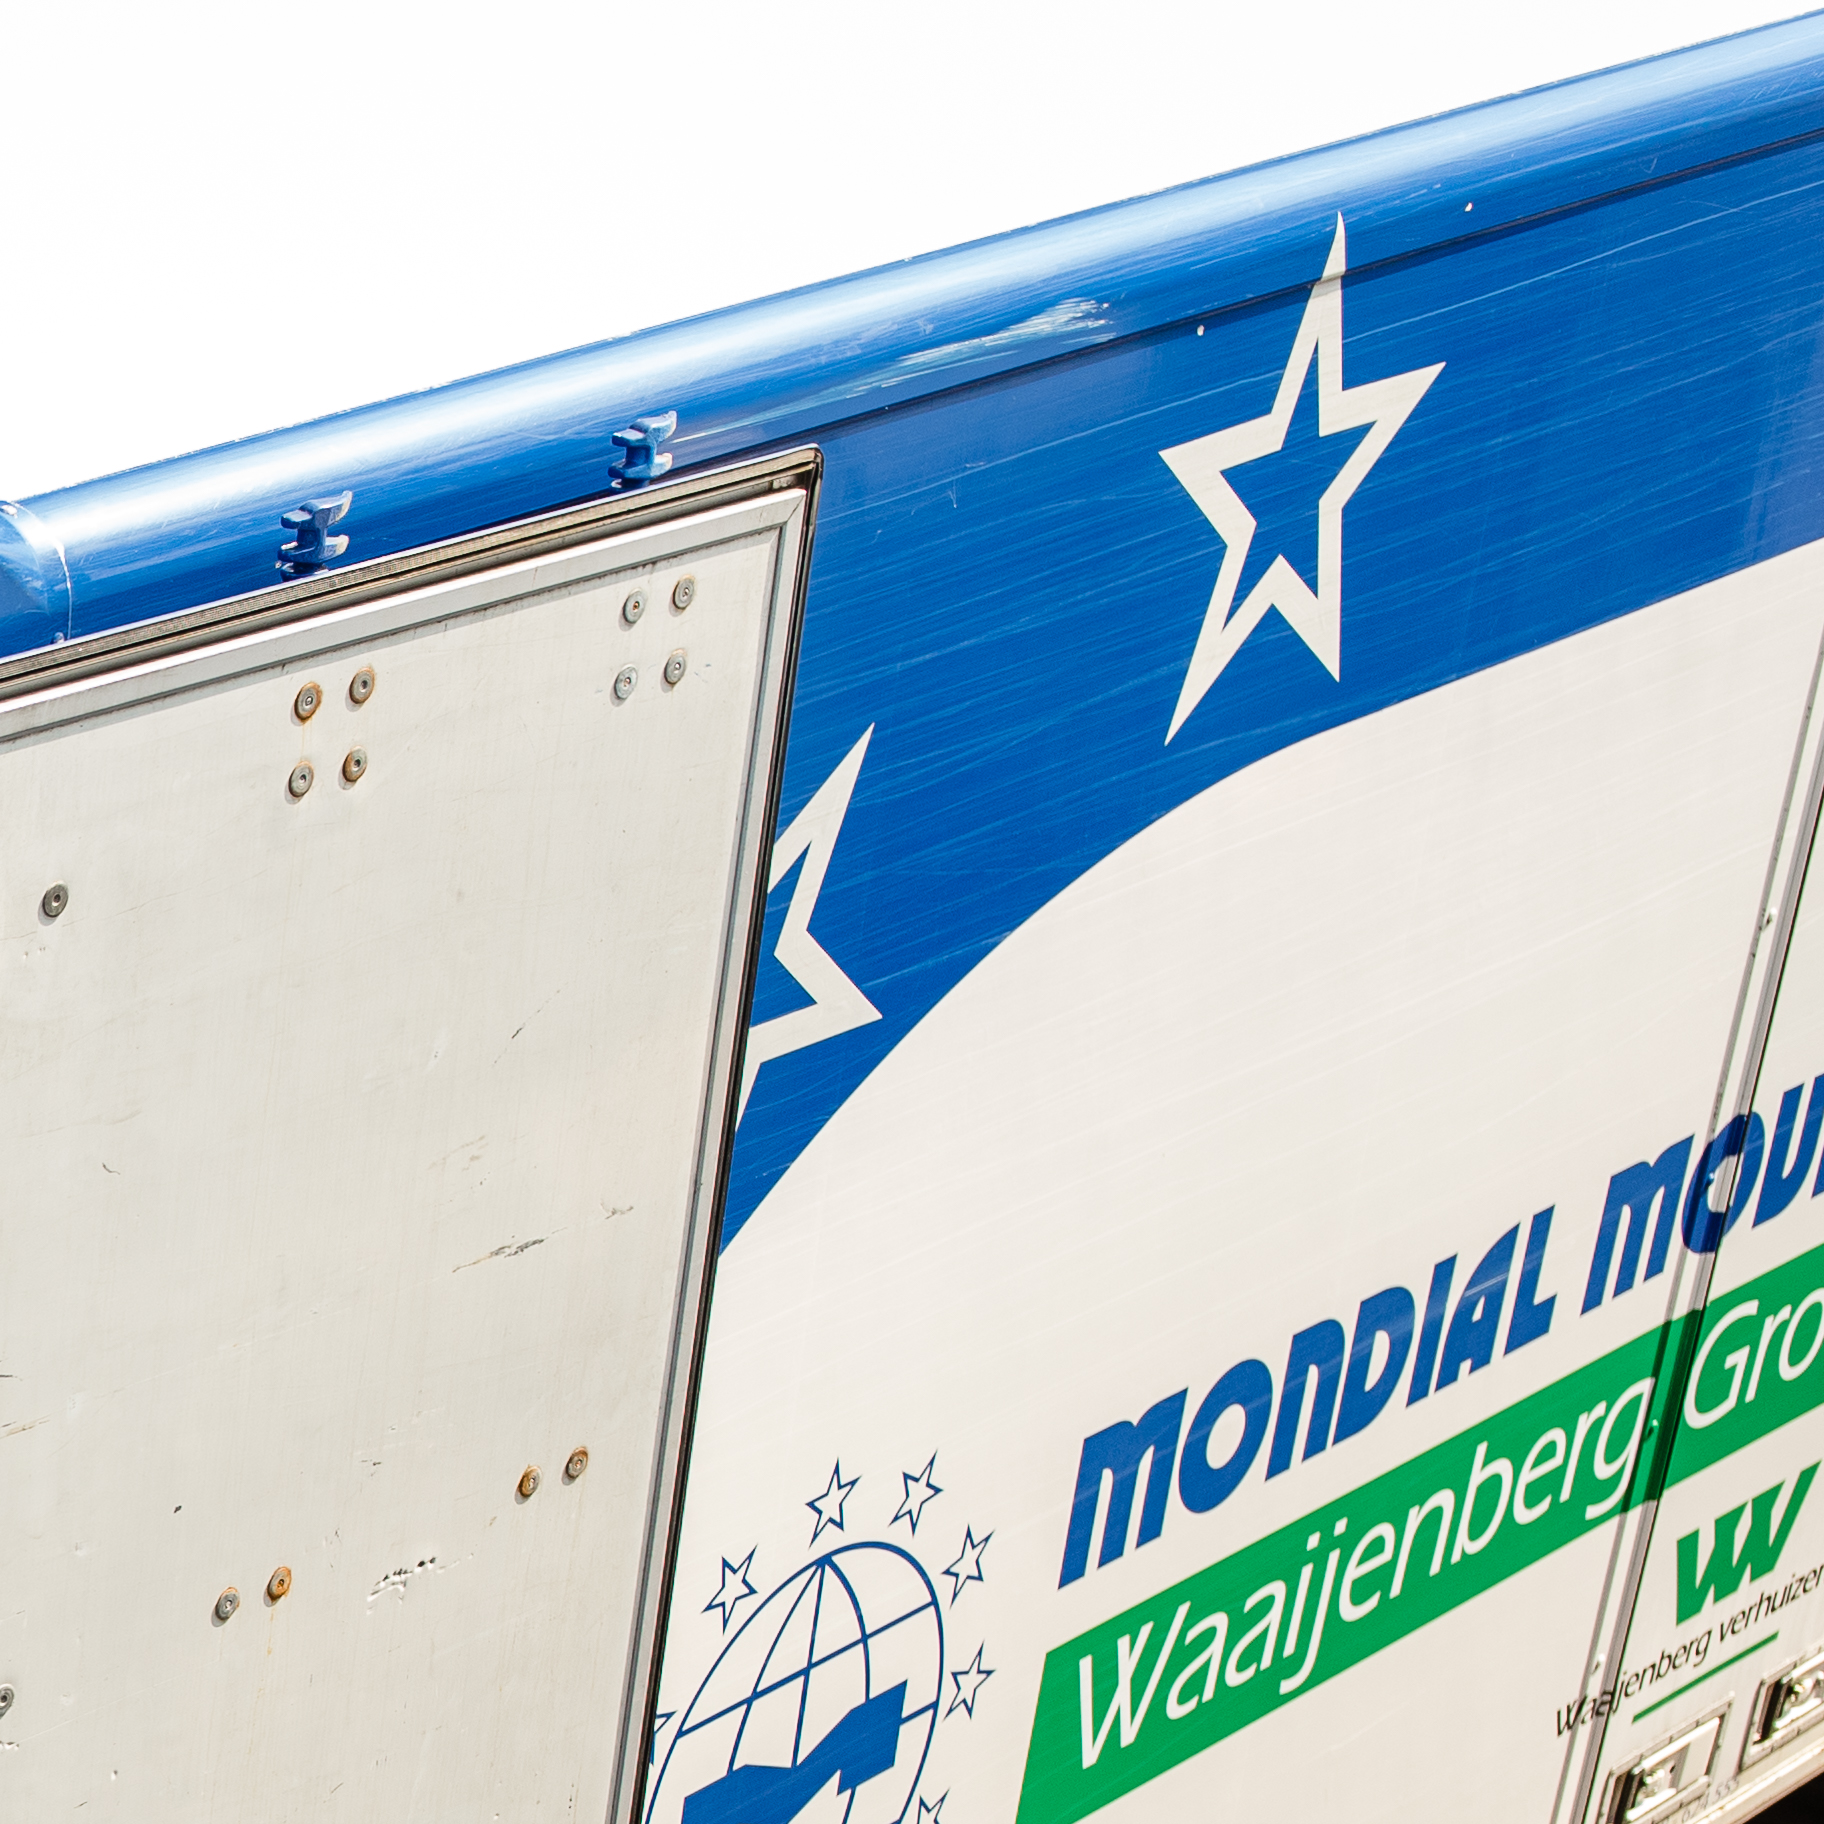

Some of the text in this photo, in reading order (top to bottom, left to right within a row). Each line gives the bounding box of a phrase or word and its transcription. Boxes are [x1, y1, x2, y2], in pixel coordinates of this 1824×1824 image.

[1057, 1072, 1824, 1590] MONDIAL MOV
[1079, 1288, 1824, 1770] Waaijenberg Gro
